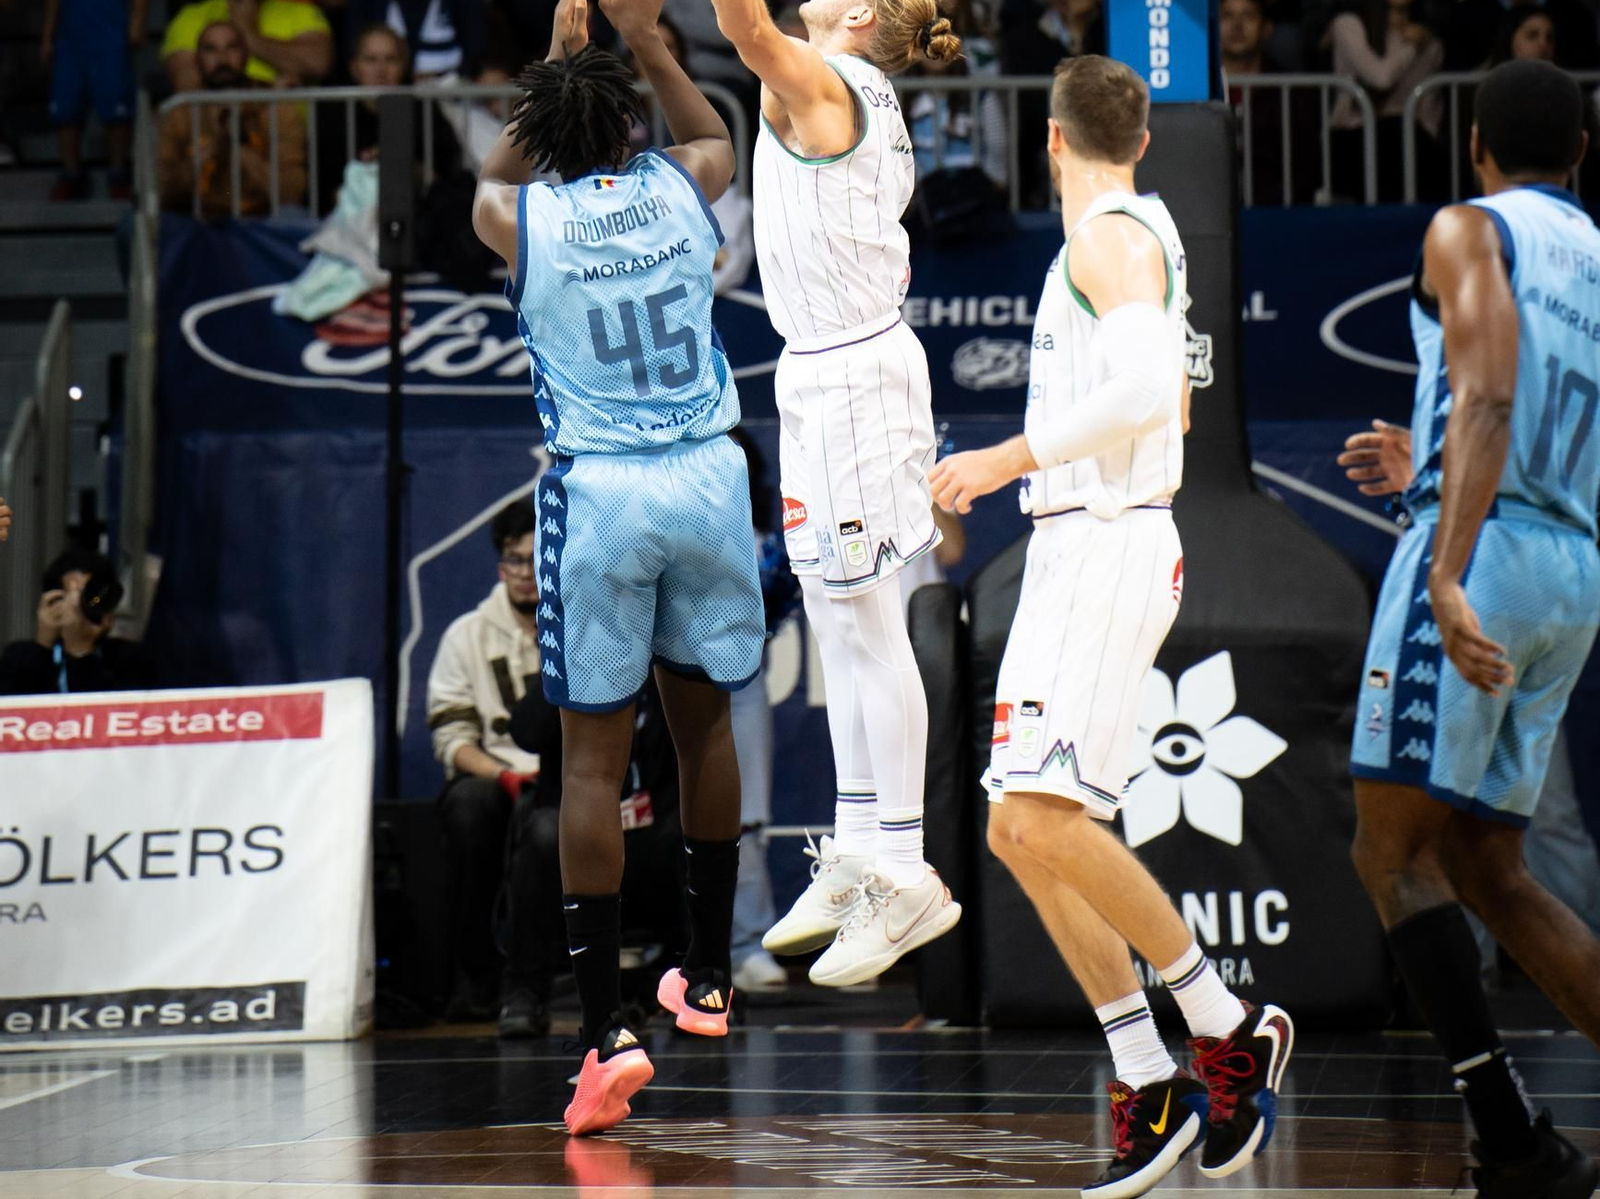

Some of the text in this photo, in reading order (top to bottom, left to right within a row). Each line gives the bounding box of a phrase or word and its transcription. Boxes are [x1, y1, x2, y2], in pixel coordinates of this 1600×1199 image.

[563, 194, 672, 244] DOUMBOUYA
[583, 238, 692, 282] MORABANC
[1241, 289, 1279, 322] L
[587, 283, 700, 398] 45
[0, 708, 265, 743] Real Estate
[1166, 889, 1290, 947] NIC
[4, 990, 276, 1034] elkers.ad
